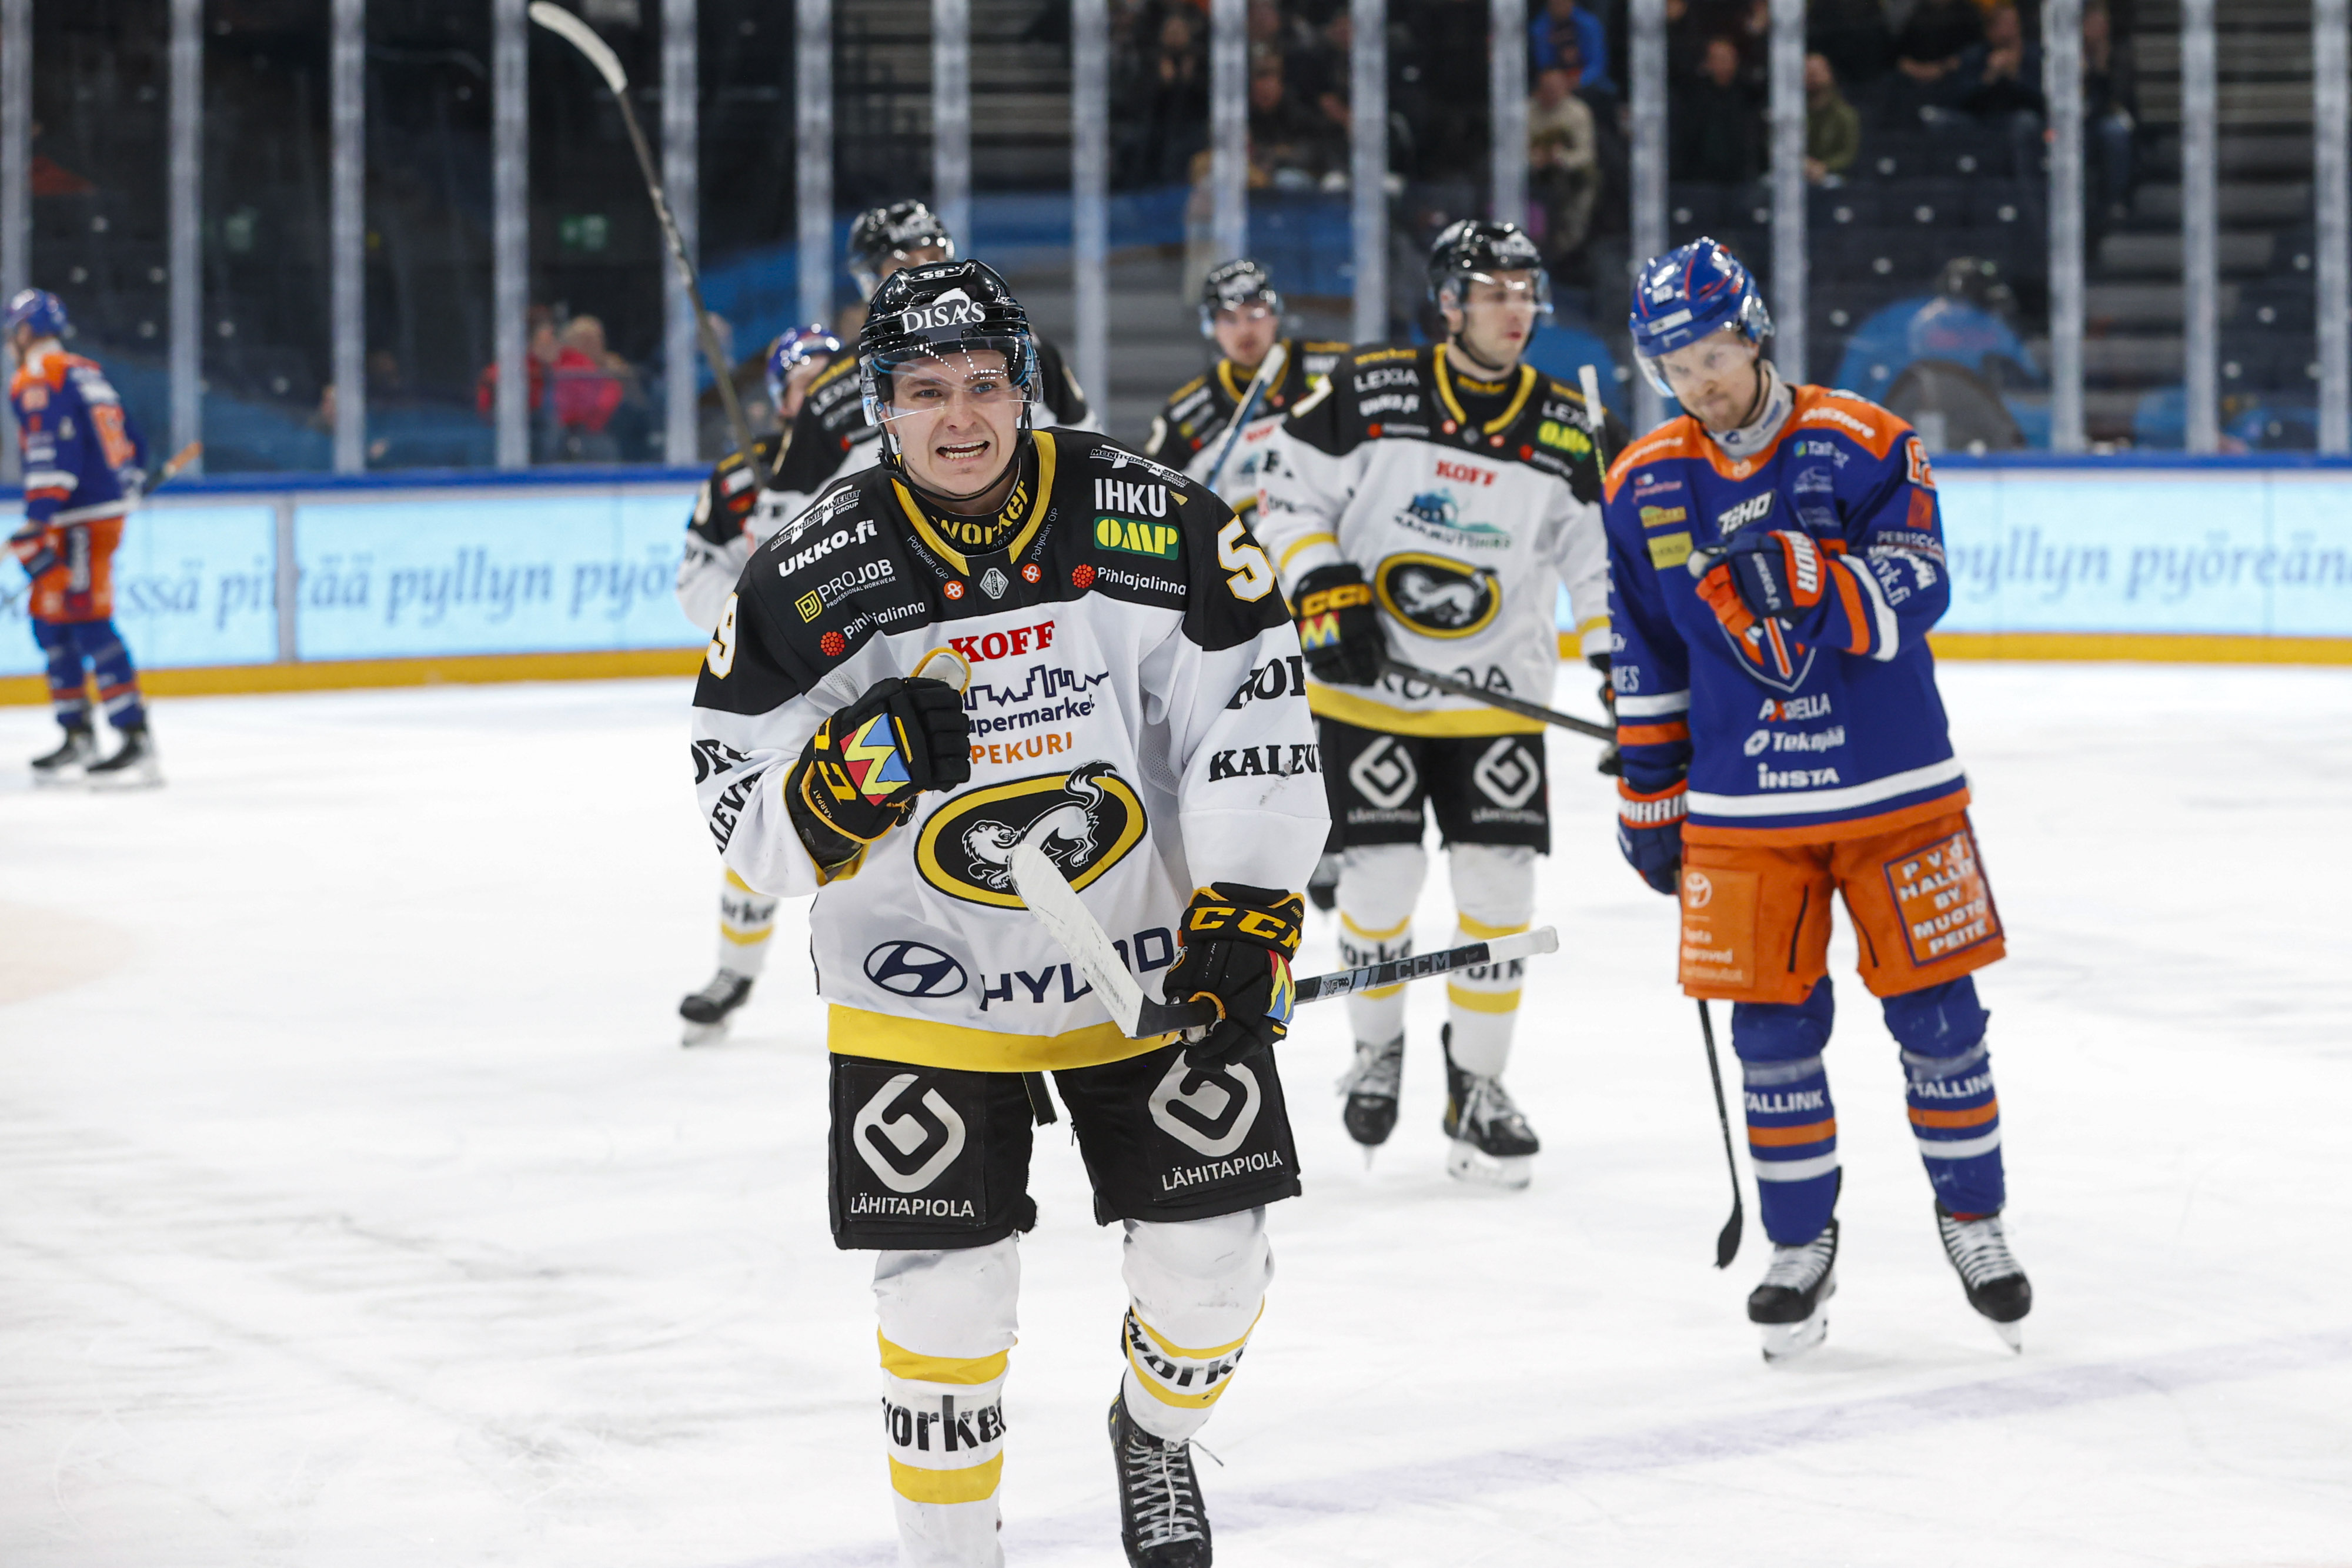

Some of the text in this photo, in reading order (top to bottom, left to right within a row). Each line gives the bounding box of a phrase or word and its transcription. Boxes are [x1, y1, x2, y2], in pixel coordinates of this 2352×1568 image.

[923, 270, 946, 279] 59
[901, 302, 986, 335] DISAS
[1094, 478, 1167, 517] IHKU
[1162, 476, 1185, 489] GROUP
[836, 502, 859, 515] GROUP
[1031, 507, 1058, 561] Pohjolan OP
[1097, 519, 1178, 555] OMP
[907, 535, 949, 580] Pohjolan OP
[1217, 514, 1276, 603] 5
[817, 559, 894, 602] PROJOB
[826, 576, 897, 609] PROFESSIONAL WORKWEAR
[990, 571, 999, 596] TACKLA
[1098, 566, 1186, 596] Pihlajalinna
[706, 591, 739, 680] 9
[948, 620, 1055, 663] KOFF
[971, 731, 1073, 764] PEKURI
[1189, 906, 1302, 956] CCM
[1394, 951, 1451, 981] CCM
[1161, 1149, 1283, 1192] LÄHITAPIOLA
[850, 1192, 975, 1217] LÄHITAPIOLA
